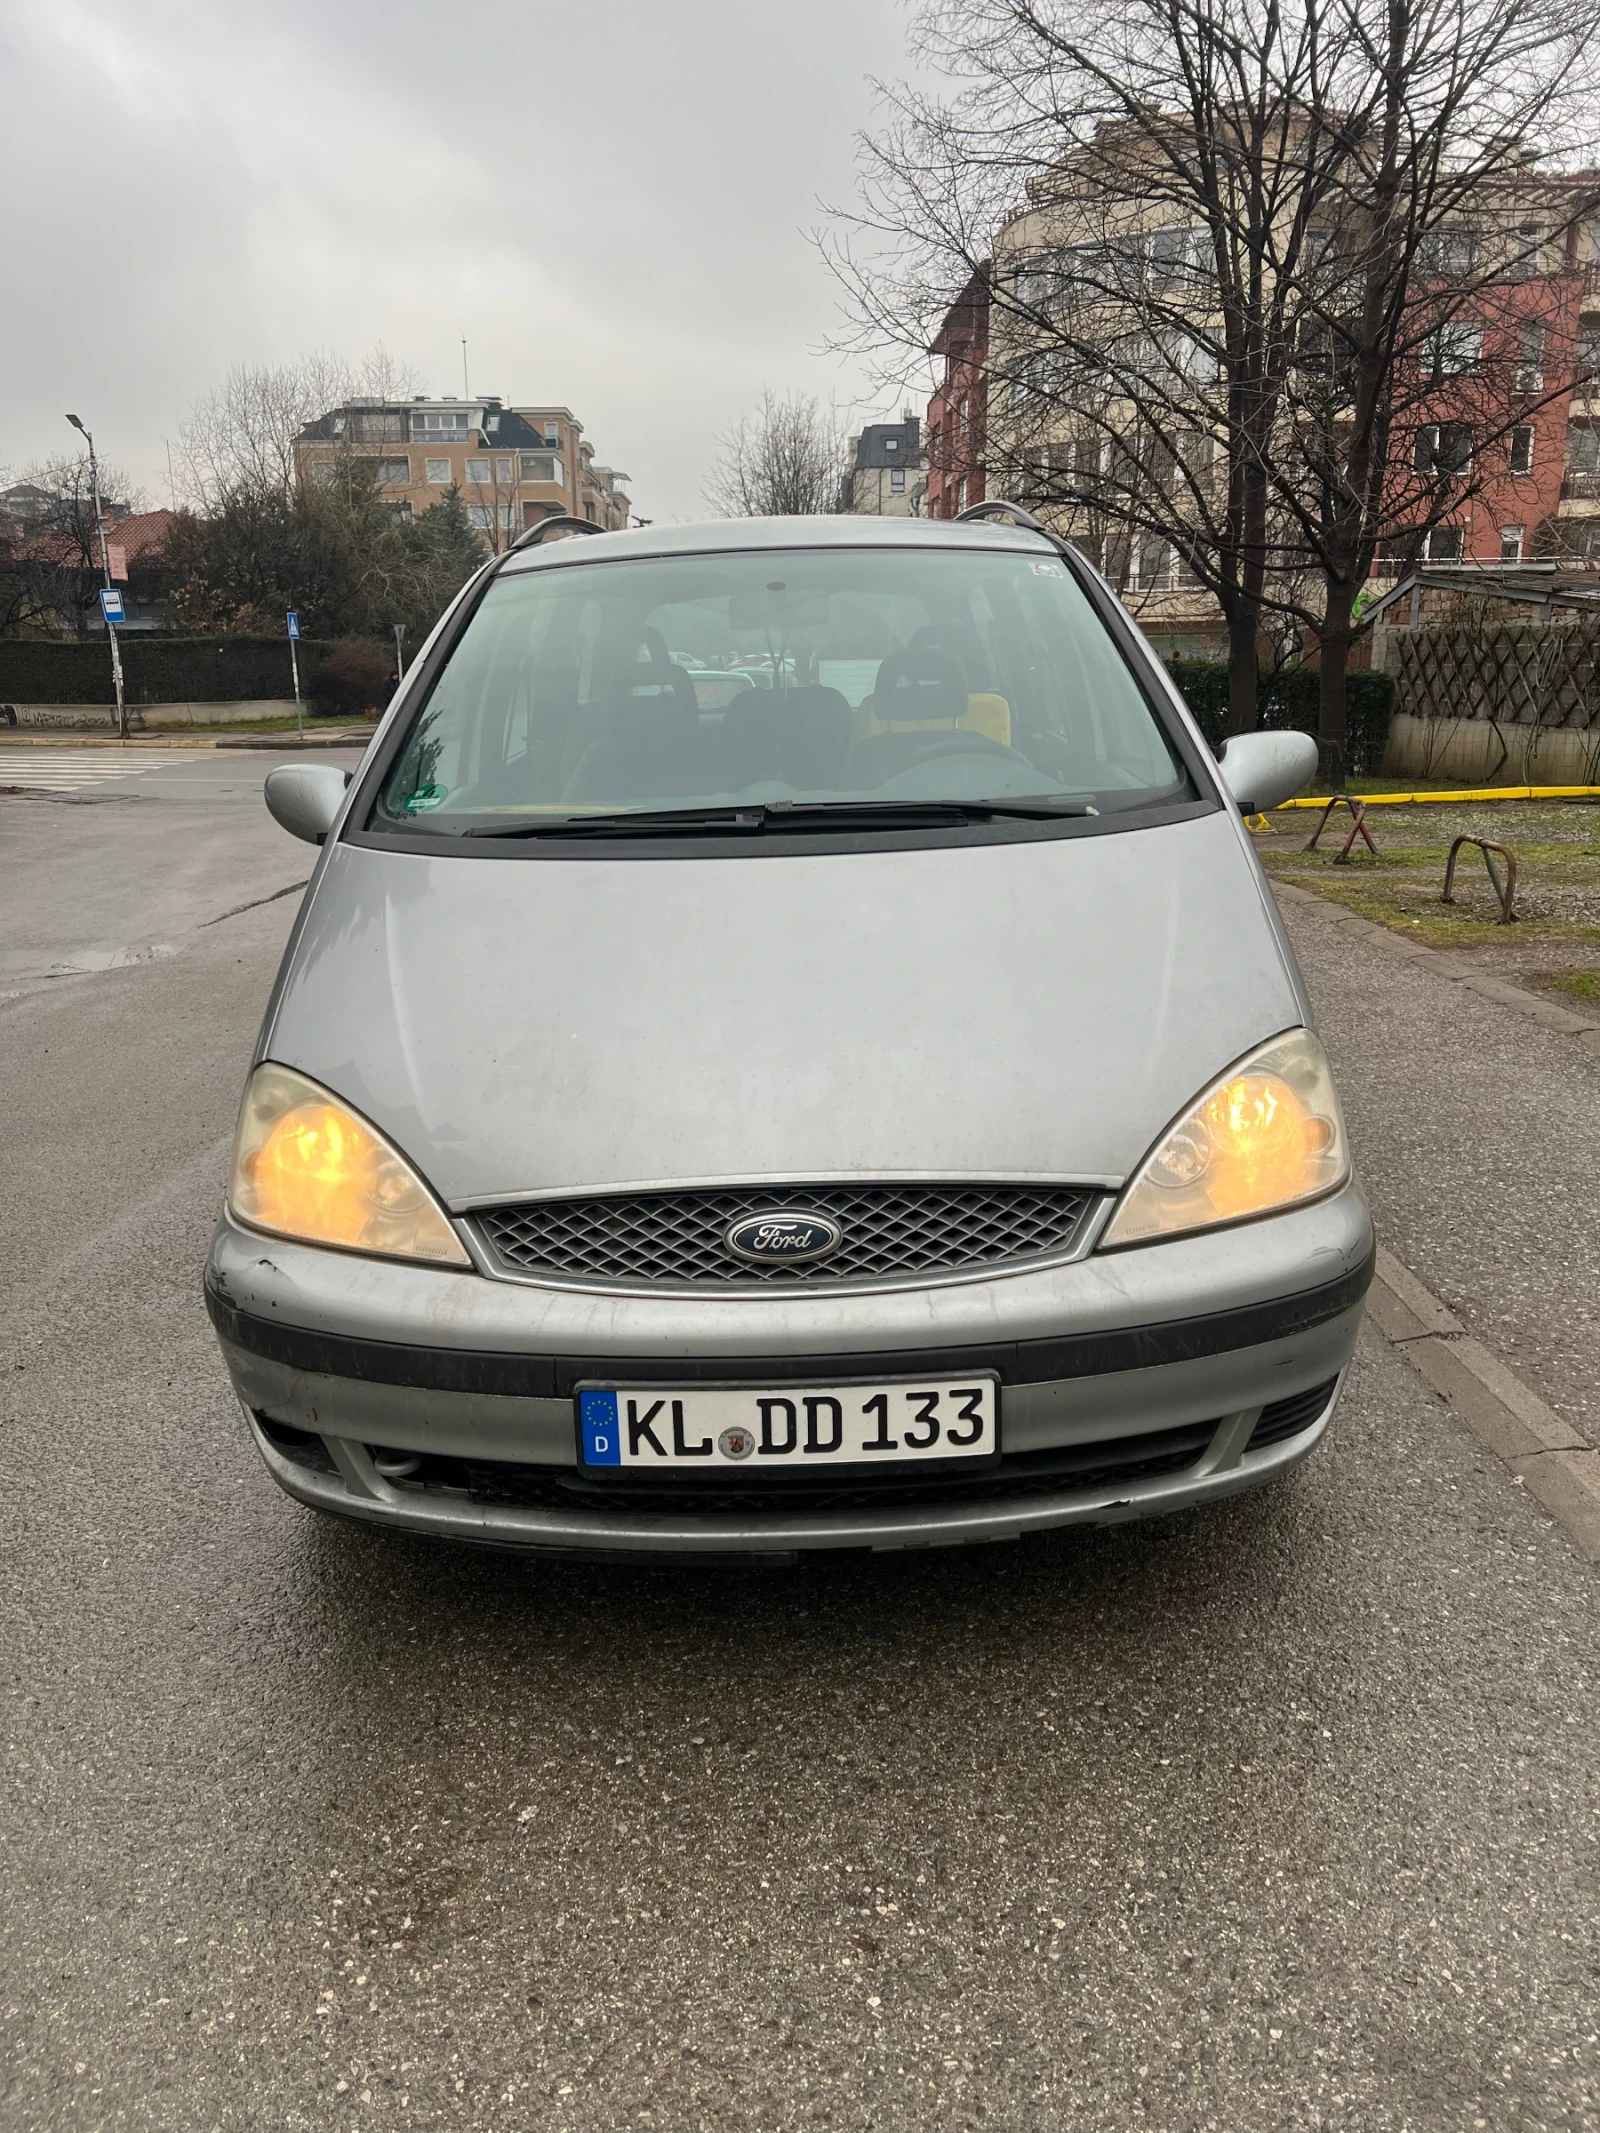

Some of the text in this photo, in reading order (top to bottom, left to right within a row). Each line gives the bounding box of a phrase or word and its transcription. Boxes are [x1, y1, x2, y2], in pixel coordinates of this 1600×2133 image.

[753, 1224, 813, 1250] Ford
[627, 1399, 713, 1457] KL
[756, 1397, 842, 1456] DD
[862, 1388, 984, 1451] 133
[595, 1435, 609, 1453] D
